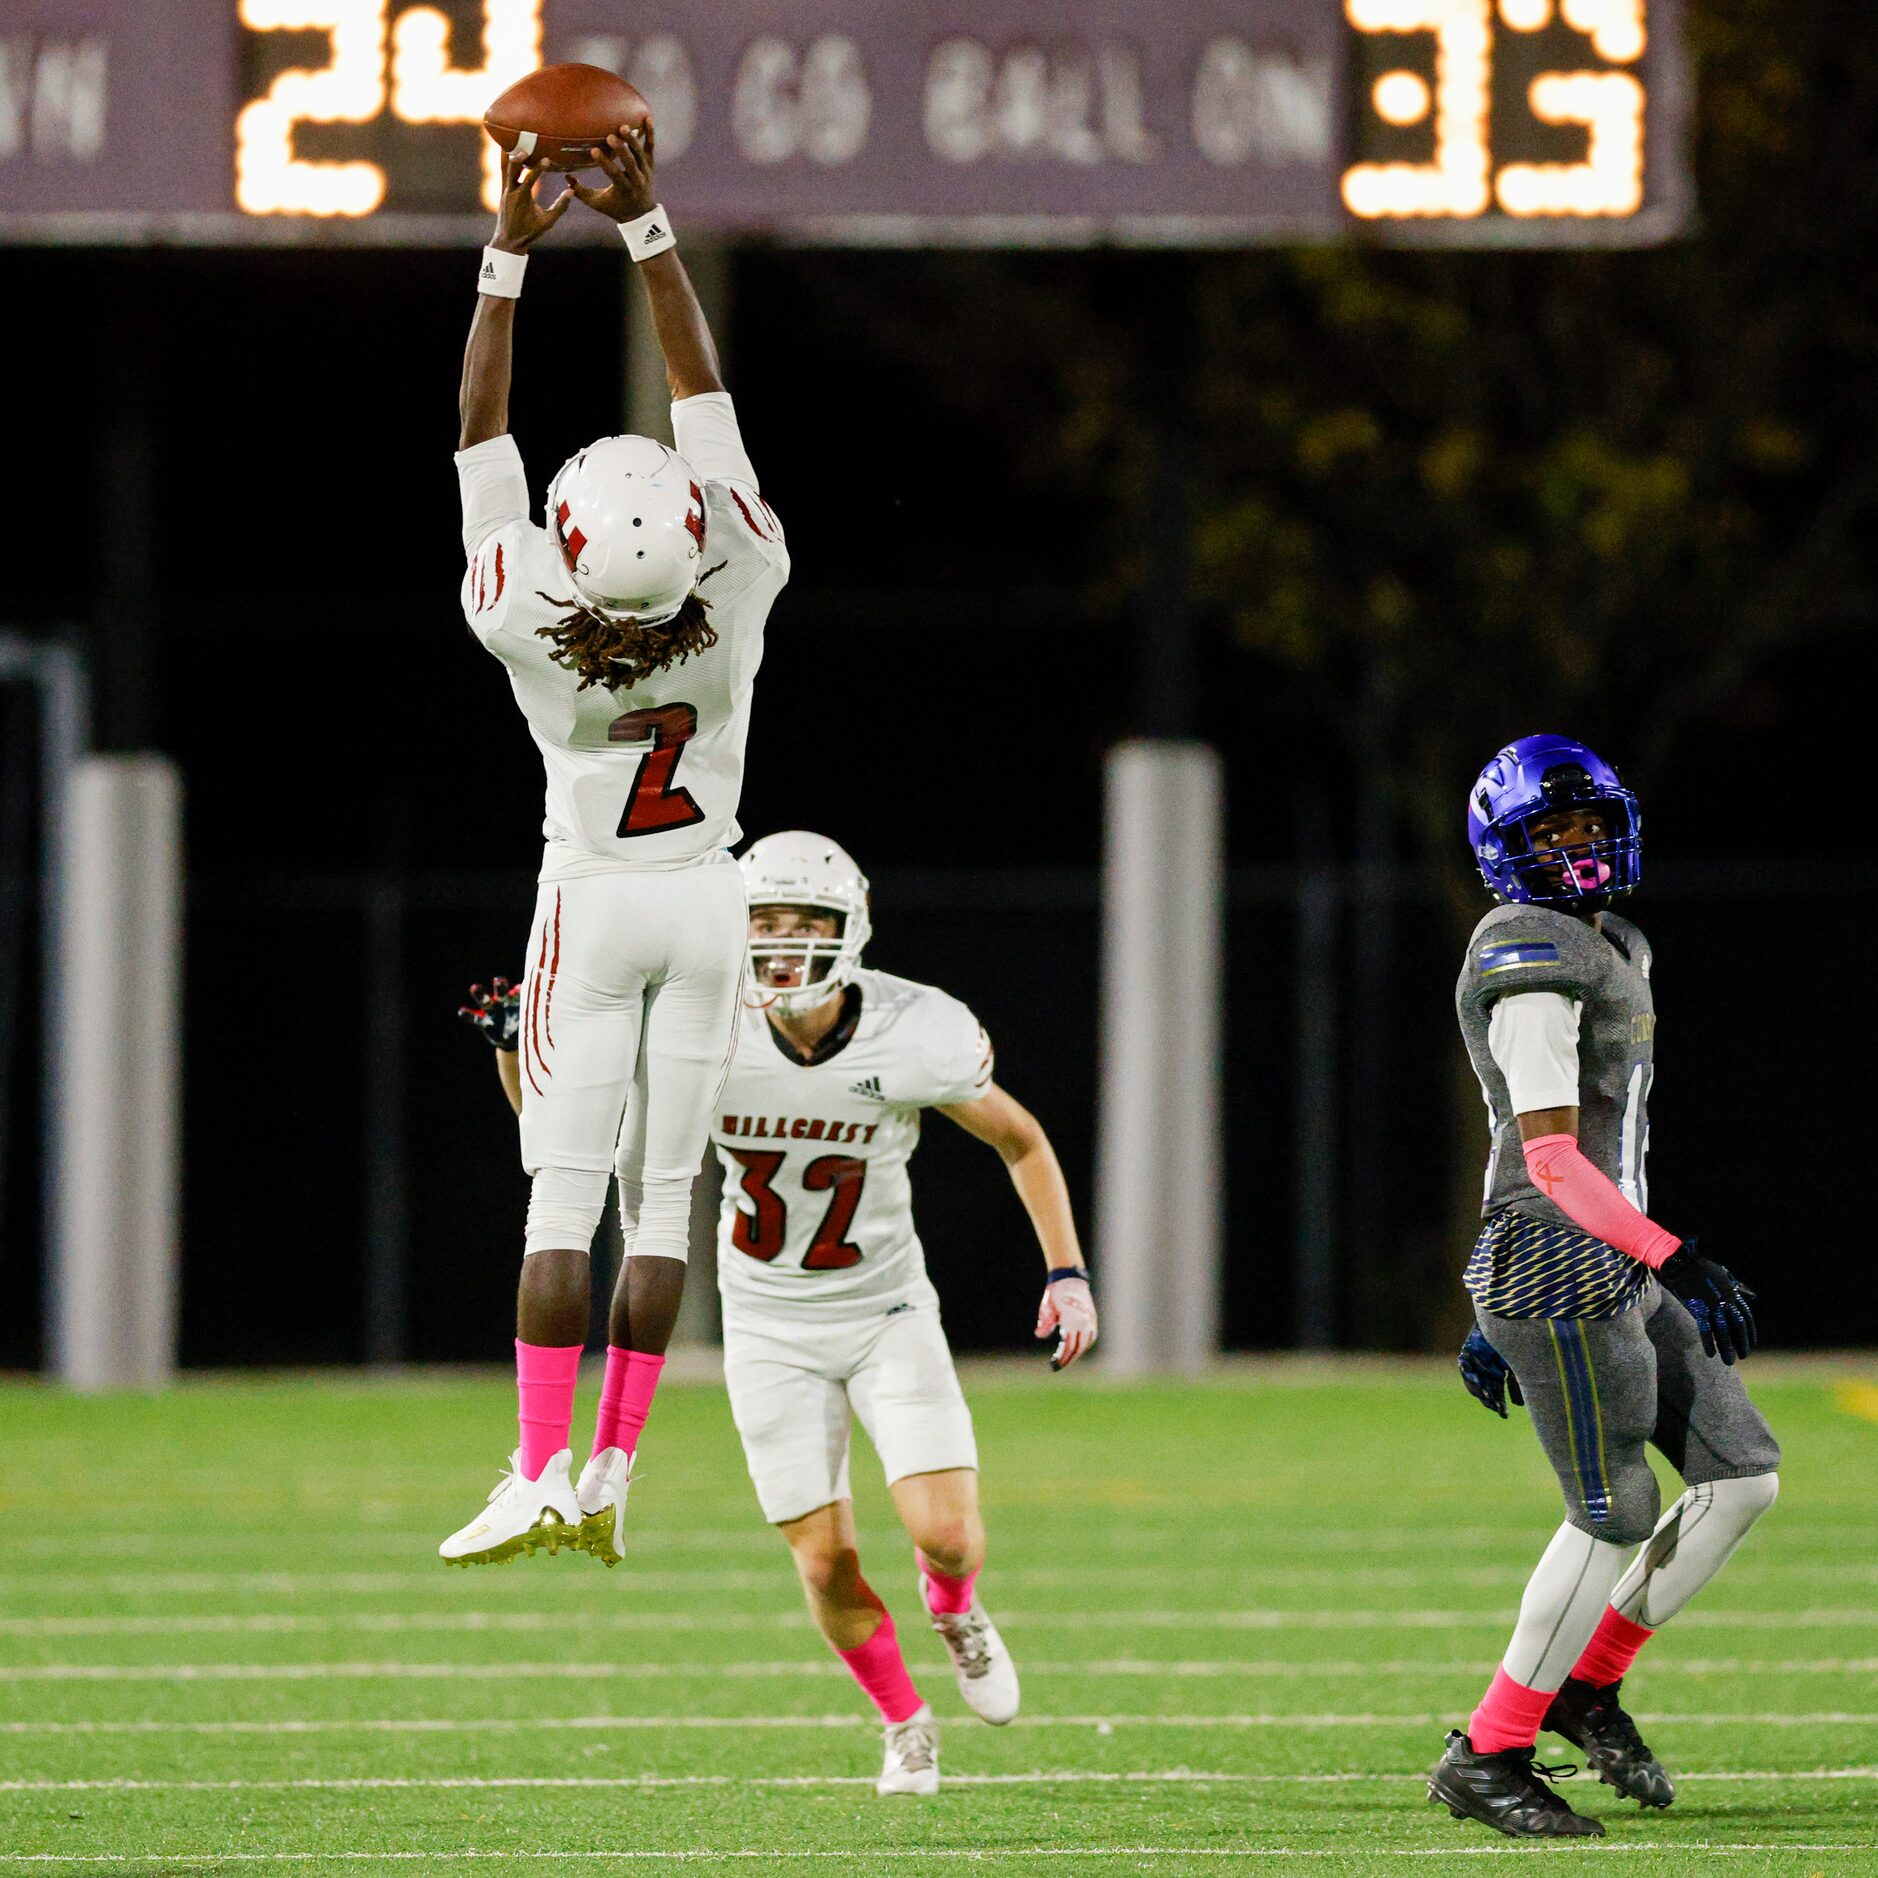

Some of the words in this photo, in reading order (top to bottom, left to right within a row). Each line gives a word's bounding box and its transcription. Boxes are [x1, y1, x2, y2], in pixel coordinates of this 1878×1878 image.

[235, 0, 543, 218] 24
[608, 701, 706, 838] 2
[721, 1115, 879, 1144] HILLCREST
[718, 1143, 867, 1270] 32
